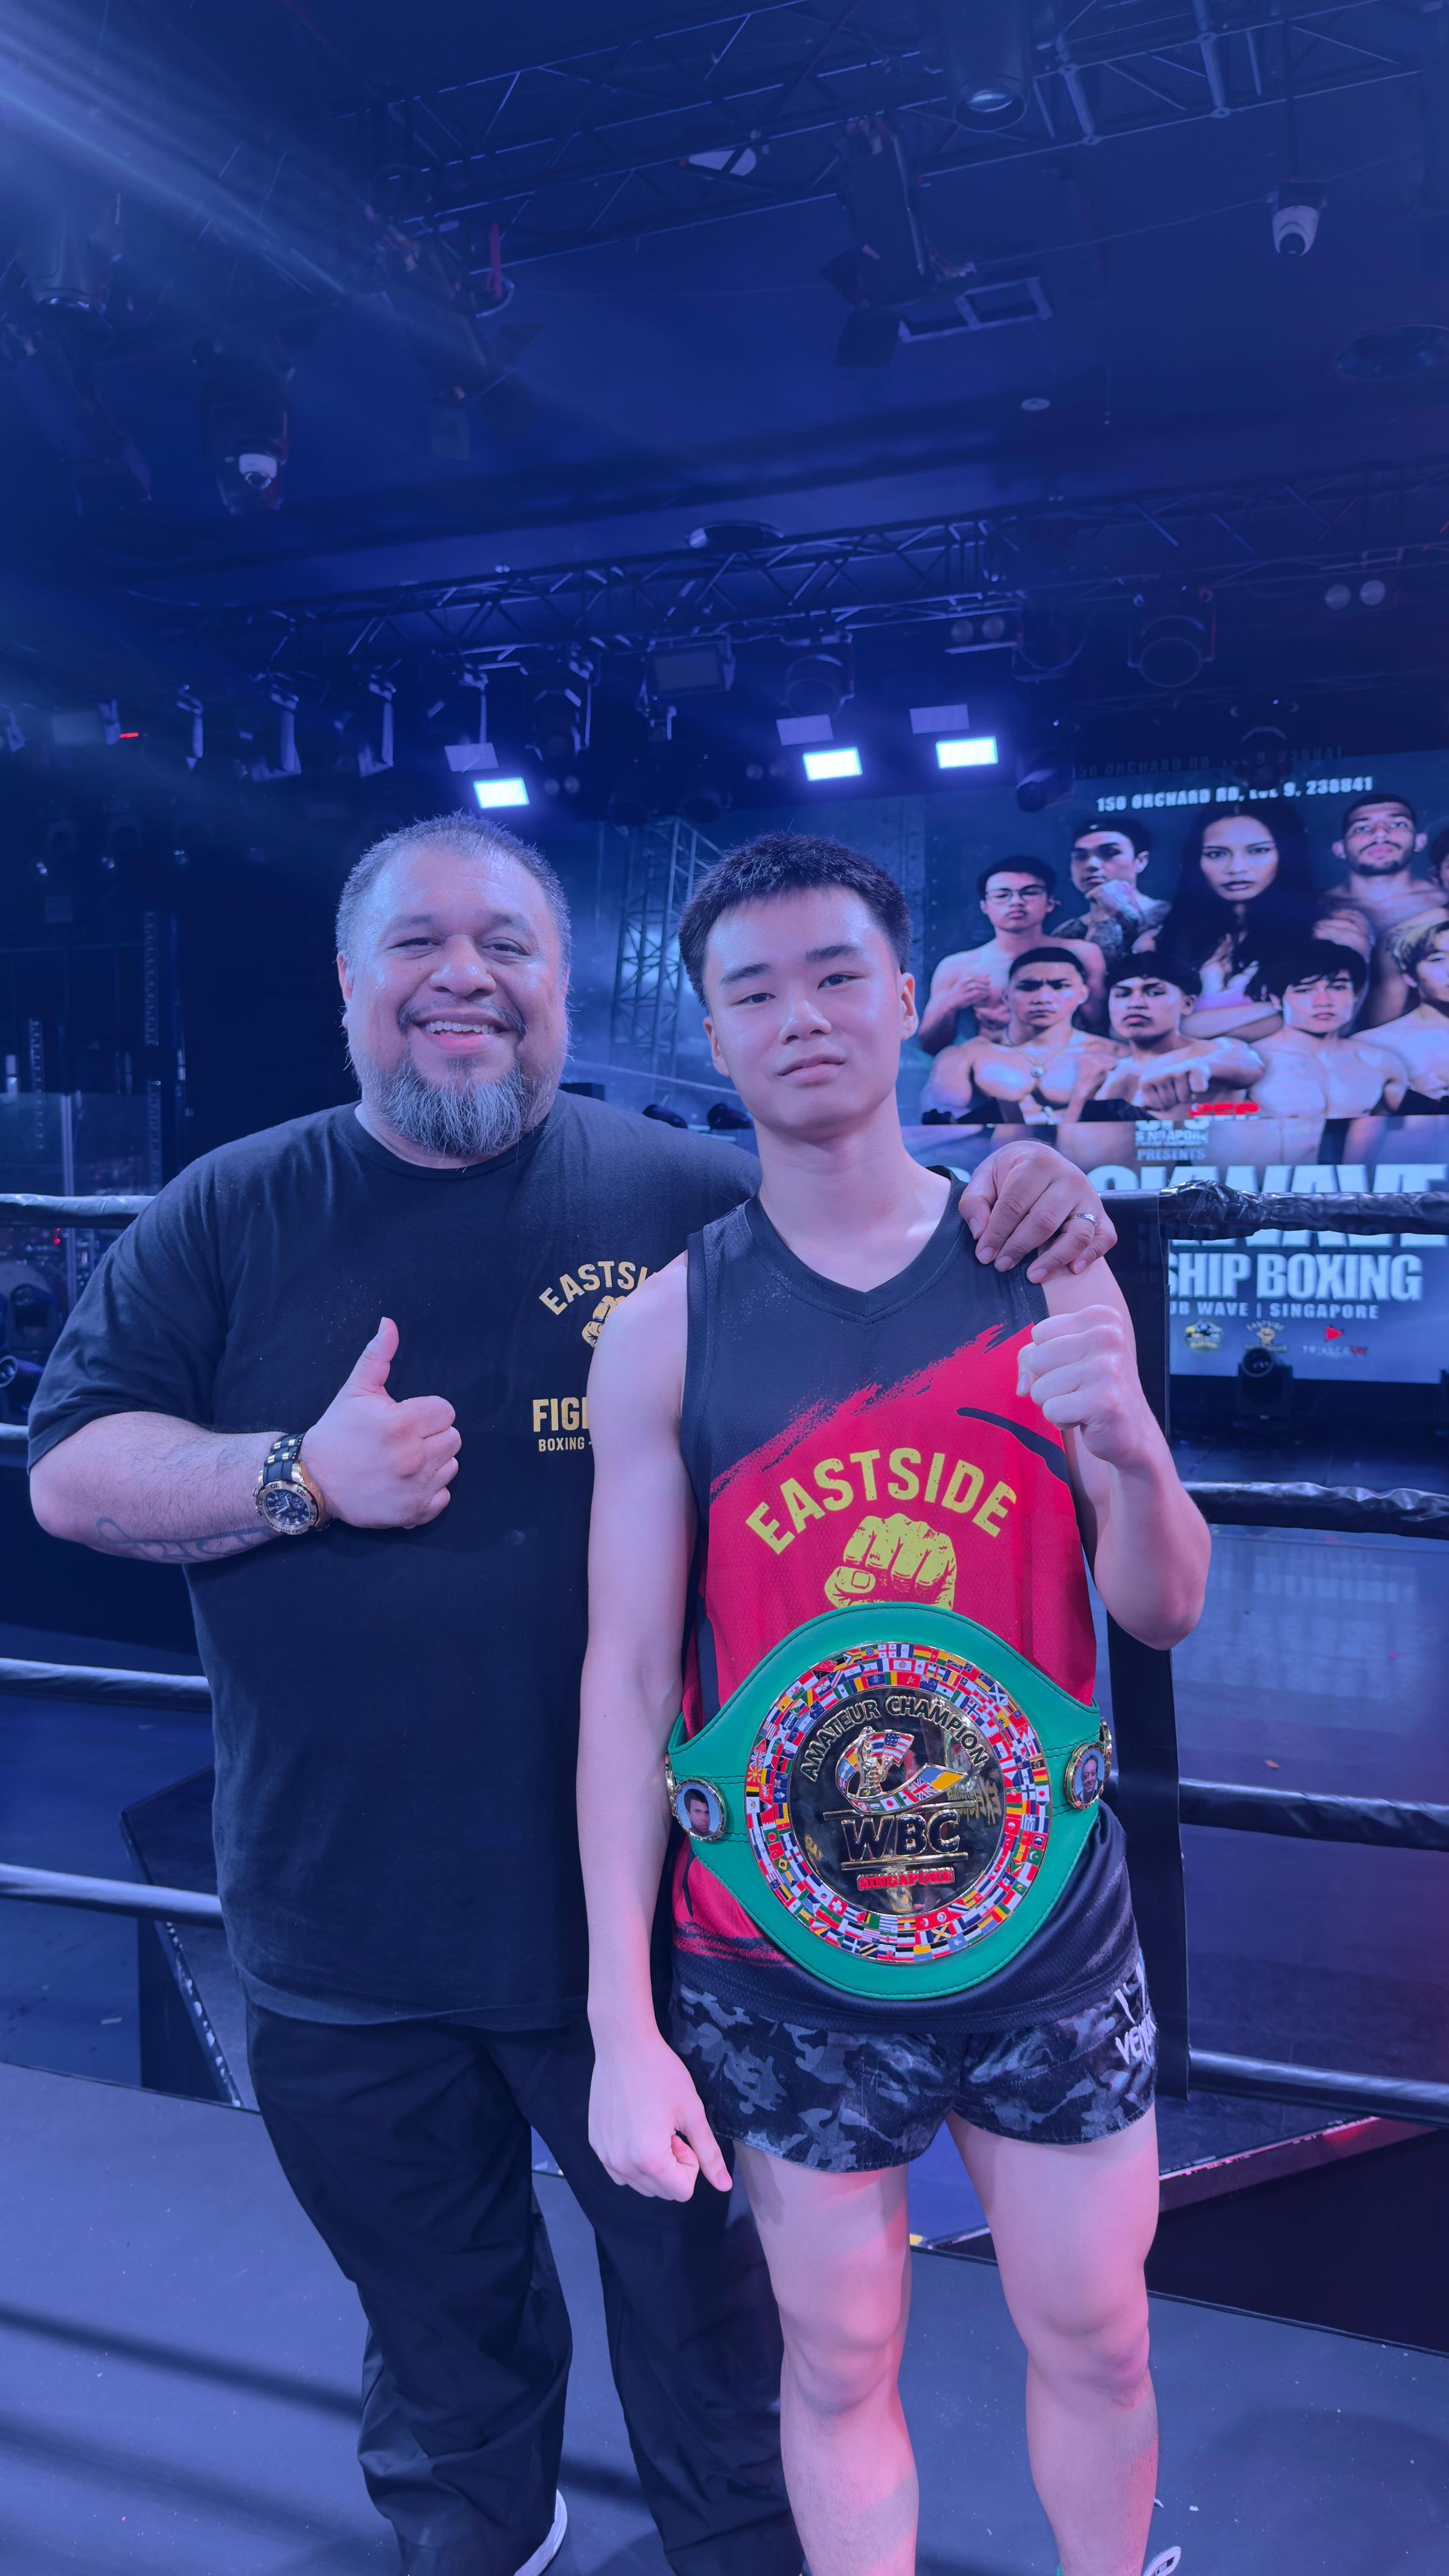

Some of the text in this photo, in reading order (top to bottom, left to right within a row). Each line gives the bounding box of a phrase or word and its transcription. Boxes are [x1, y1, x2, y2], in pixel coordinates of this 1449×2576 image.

[1131, 788, 1211, 809] ORCHARD
[1215, 786, 1245, 802] RD,
[1137, 1148, 1206, 1161] PRESENTS
[539, 1261, 657, 1315] EASTSI
[1256, 1253, 1423, 1302] BOXING
[1197, 1302, 1249, 1317] WAVE
[1269, 1302, 1380, 1320] SINGAPORE
[539, 1437, 585, 1452] BOXING
[745, 1447, 1017, 1555] EASTSIDE
[801, 1695, 989, 1782] AMATEUR CHAMPION
[841, 1809, 960, 1862] WBC
[857, 1870, 954, 1891] SINGAPORE
